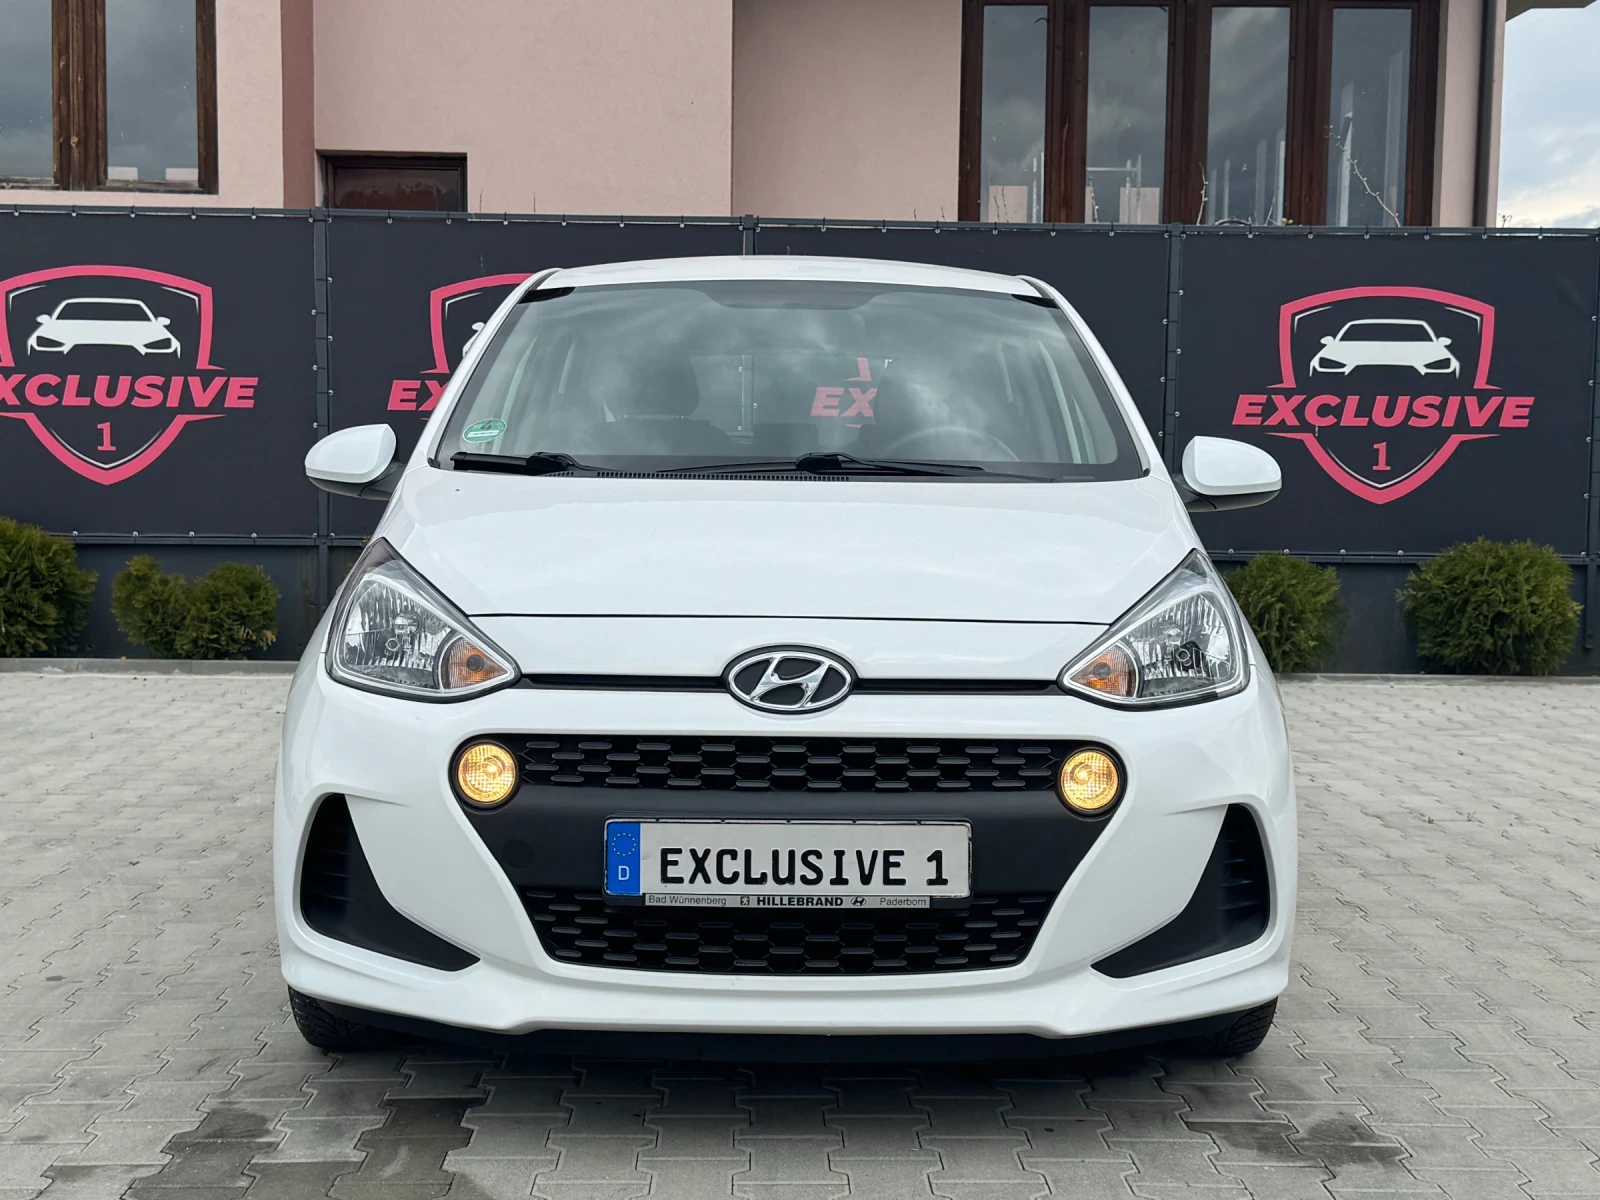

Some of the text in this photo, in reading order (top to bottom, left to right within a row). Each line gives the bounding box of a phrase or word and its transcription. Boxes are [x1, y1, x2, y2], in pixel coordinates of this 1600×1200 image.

[1232, 394, 1535, 428] EXCLUSIVE
[97, 422, 117, 451] 1
[1372, 442, 1391, 471] 1
[618, 865, 630, 881] D
[660, 847, 949, 886] EXCLUSIVE 1
[648, 895, 927, 907] Bad Wünnenberg HILLEBRAND Paderborn
